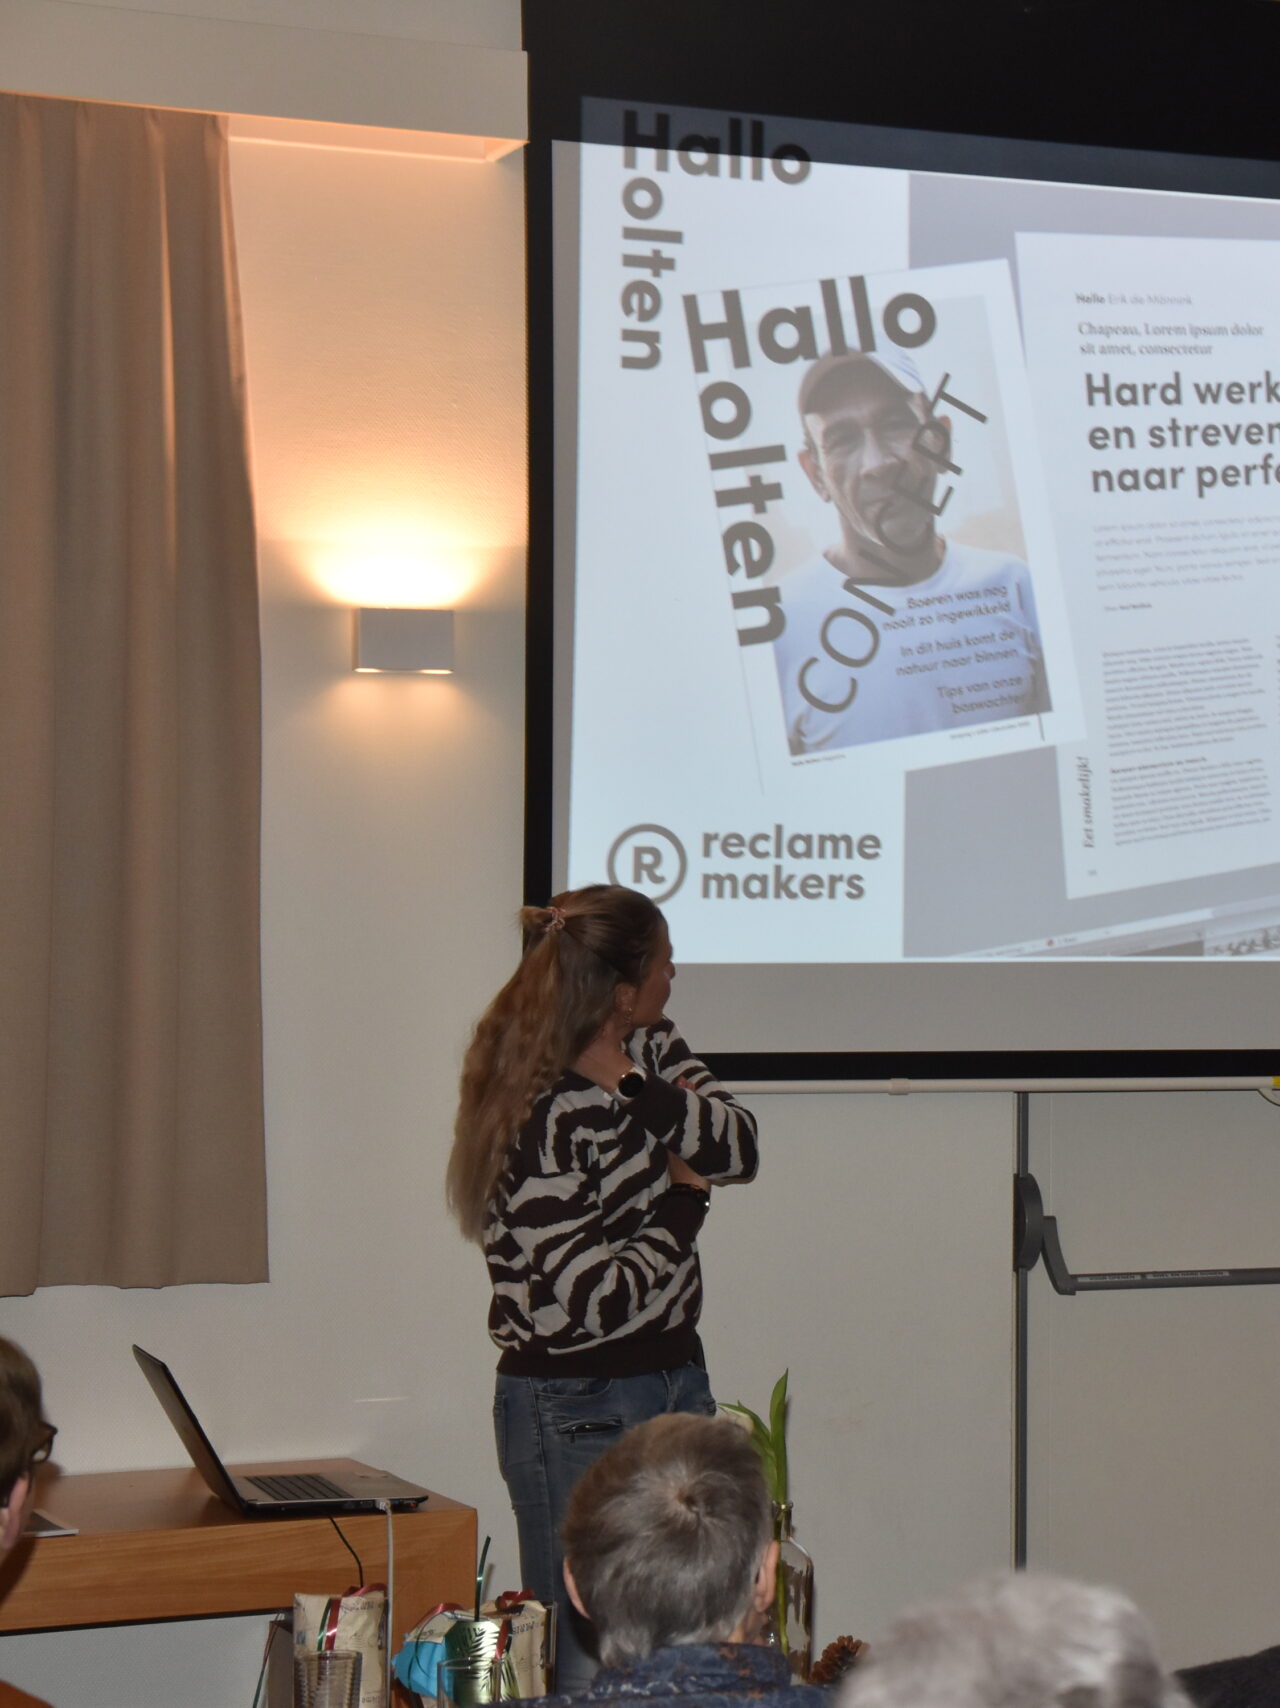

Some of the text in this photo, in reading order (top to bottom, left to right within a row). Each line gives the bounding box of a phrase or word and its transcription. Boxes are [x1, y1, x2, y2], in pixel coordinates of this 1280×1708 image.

[623, 109, 812, 186] Hallo
[682, 274, 937, 375] Hallo
[1144, 323, 1188, 336] Lorem
[1189, 323, 1229, 339] ipsum
[1230, 322, 1265, 336] dolor
[1079, 342, 1096, 355] sit
[1138, 342, 1214, 355] consectetur
[1085, 371, 1183, 406] Hard
[1088, 425, 1136, 450] en
[1091, 466, 1185, 493] naar
[907, 586, 1009, 610] Boeren was nog
[882, 600, 1012, 631] nooit zo ingewikkeld
[900, 645, 914, 658] In
[916, 642, 933, 655] dit
[935, 638, 963, 652] huis
[964, 632, 996, 647] komt
[895, 648, 1020, 677] natuur naar binnen
[936, 685, 964, 700] Tips
[965, 681, 991, 693] van
[702, 823, 882, 860] reclame
[701, 864, 866, 900] makers
